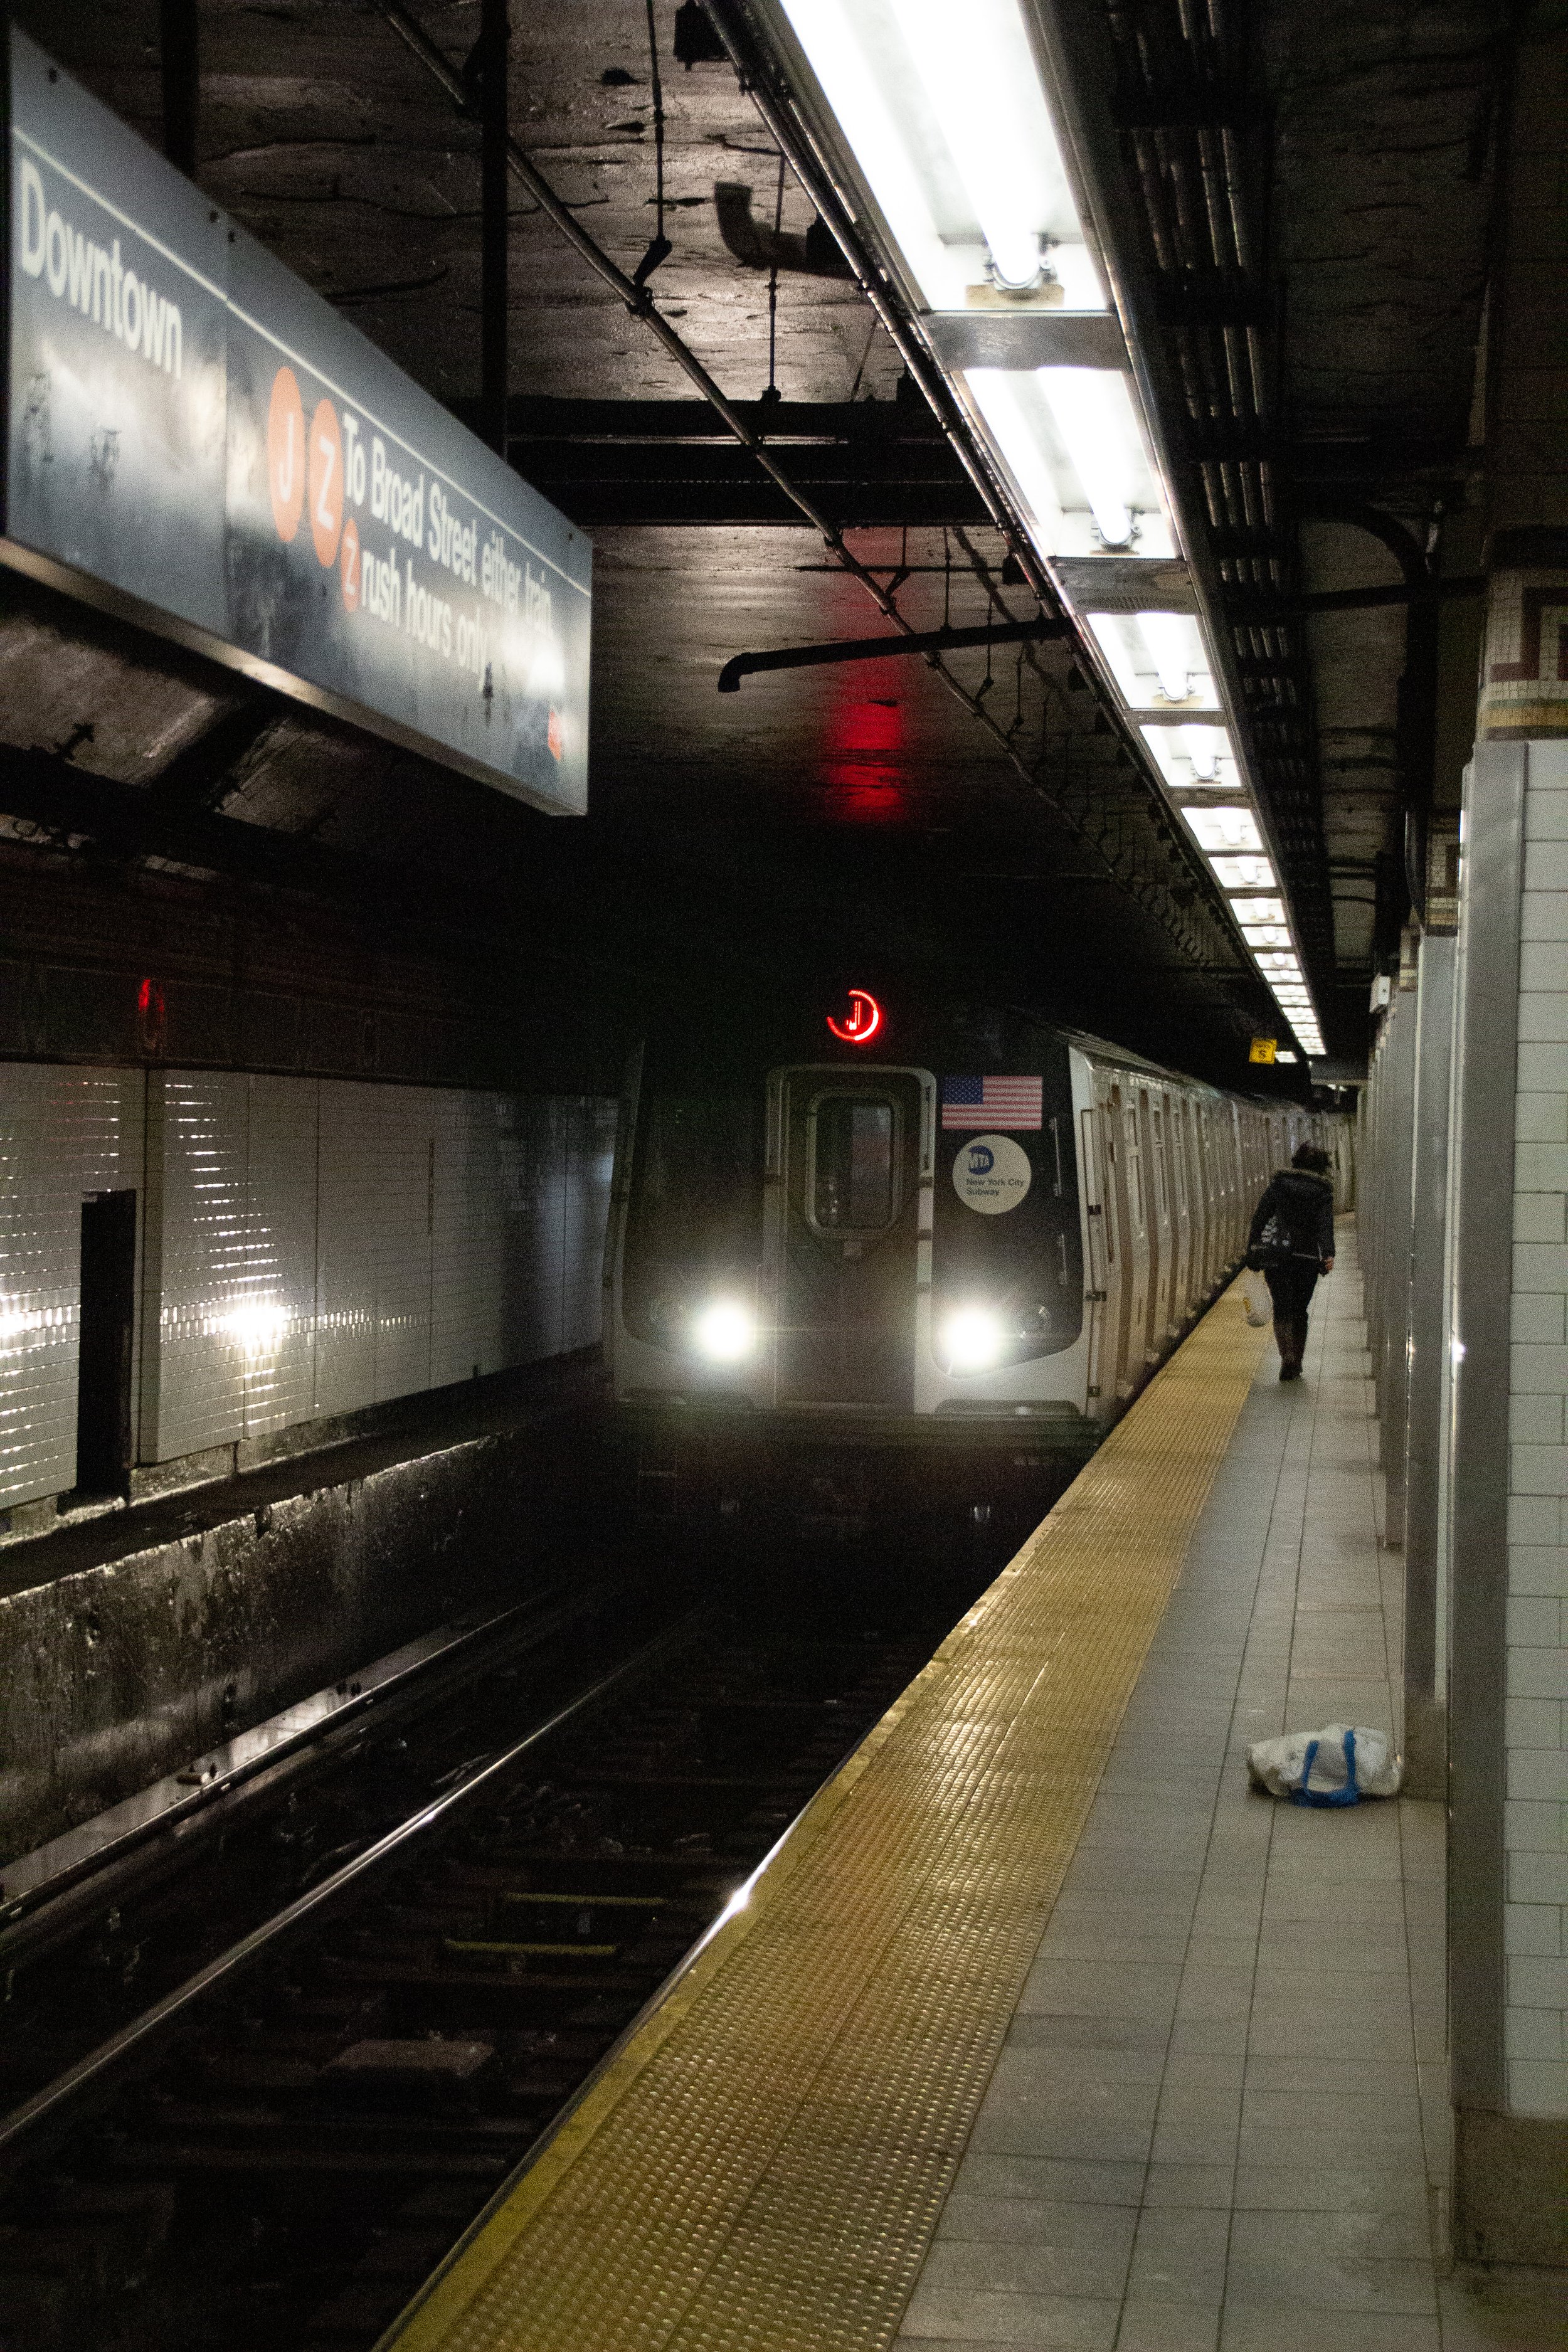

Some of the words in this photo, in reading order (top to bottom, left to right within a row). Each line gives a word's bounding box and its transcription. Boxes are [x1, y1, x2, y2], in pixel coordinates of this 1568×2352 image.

[21, 157, 183, 381] Downtown
[278, 411, 295, 503] J
[317, 434, 336, 532] Z
[342, 411, 366, 507] To
[372, 437, 425, 548] Broad
[428, 482, 477, 586] Street
[482, 529, 521, 617] either
[345, 536, 357, 596] Z
[361, 547, 401, 627] rush
[406, 559, 452, 658] hours
[966, 1178, 985, 1186] New
[987, 1178, 1006, 1187] York
[1007, 1179, 1025, 1188] City
[966, 1187, 1000, 1197] Subway
[967, 1152, 991, 1170] MTA
